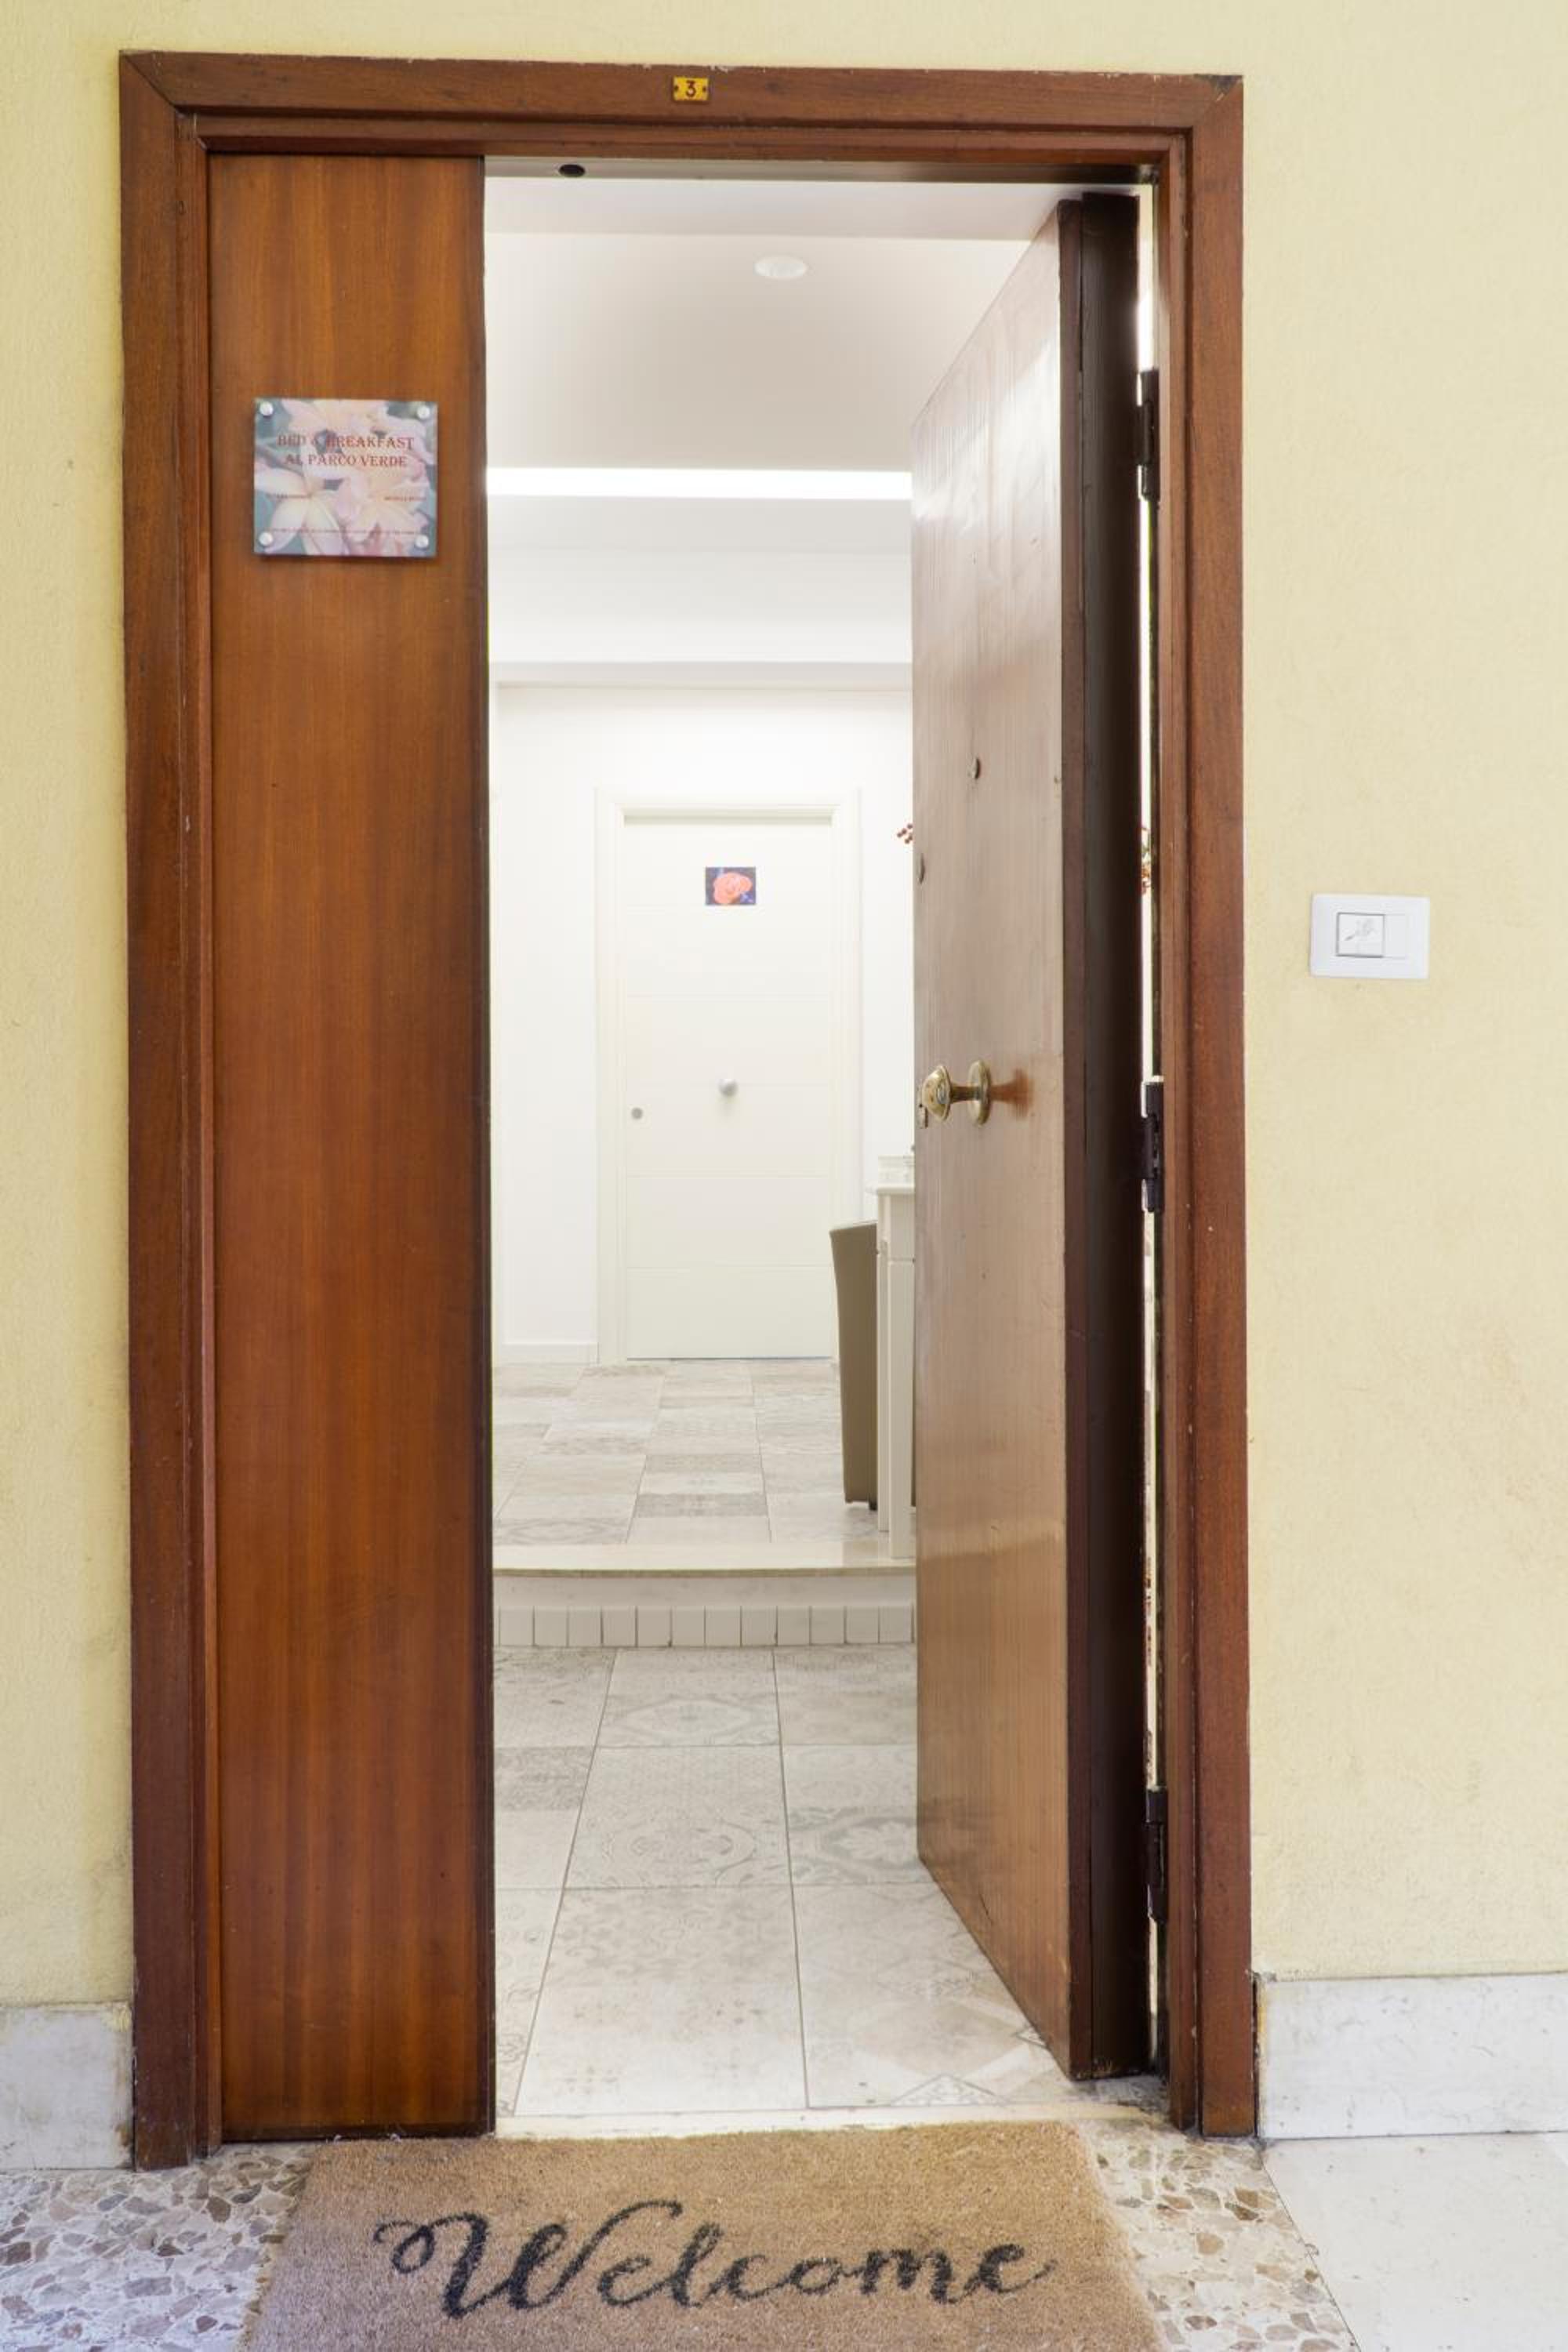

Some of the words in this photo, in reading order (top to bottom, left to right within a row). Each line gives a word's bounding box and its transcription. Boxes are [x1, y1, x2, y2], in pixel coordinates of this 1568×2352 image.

[685, 79, 697, 98] 3
[277, 434, 307, 448] BED
[325, 434, 415, 451] BREAKFAST
[284, 453, 303, 466] AL
[308, 454, 357, 466] PARCO
[360, 455, 408, 467] VERDE
[374, 2201, 1057, 2319] Welcome
